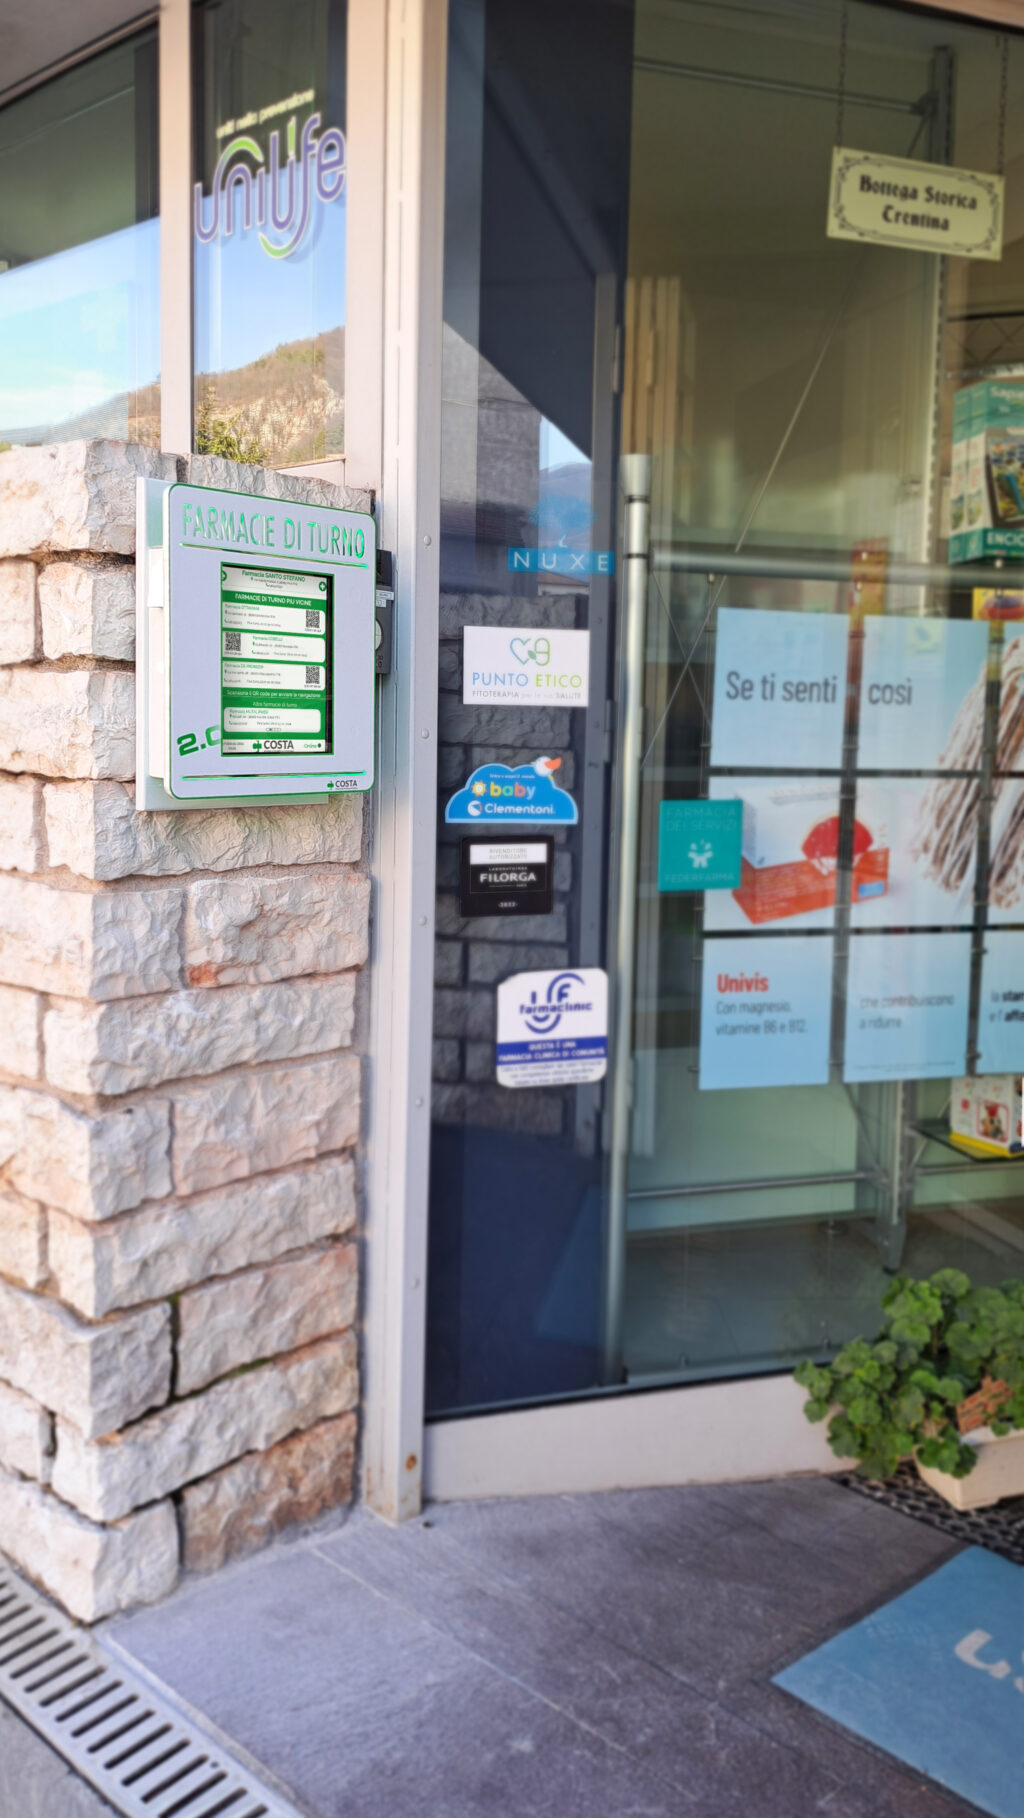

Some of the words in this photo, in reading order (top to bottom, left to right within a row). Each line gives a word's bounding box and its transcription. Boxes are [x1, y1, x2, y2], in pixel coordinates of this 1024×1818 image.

[859, 174, 919, 202] Bottega
[924, 186, 978, 210] Storica
[882, 204, 950, 231] Trentina
[182, 503, 275, 547] FARMACIE
[283, 517, 301, 550] DI
[307, 521, 365, 559] TURNO
[513, 551, 608, 572] NUXE
[241, 570, 265, 578] Farmacia
[265, 572, 284, 580] SANTO
[283, 574, 306, 582] STEFANO
[234, 593, 261, 602] FARMACIE
[295, 598, 312, 606] VICINE
[472, 672, 529, 687] PUNTO
[535, 673, 582, 688] ETICO
[726, 670, 754, 701] Se
[761, 673, 775, 701] ti
[782, 675, 837, 704] senti
[472, 690, 520, 698] FITOTERAPIA
[263, 740, 294, 750] COSTA
[335, 780, 358, 788] COSTA
[489, 781, 536, 800] baby
[484, 803, 554, 815] Clementoni
[666, 807, 736, 818] FARMACIA
[480, 872, 537, 883] FILORGA
[716, 972, 769, 994] Univis
[520, 1002, 593, 1014] farmaclinic
[716, 1001, 736, 1015] Con
[715, 1022, 761, 1036] vitamine
[763, 1020, 777, 1034] B6
[779, 1022, 786, 1034] e
[869, 1017, 902, 1029] ridurre
